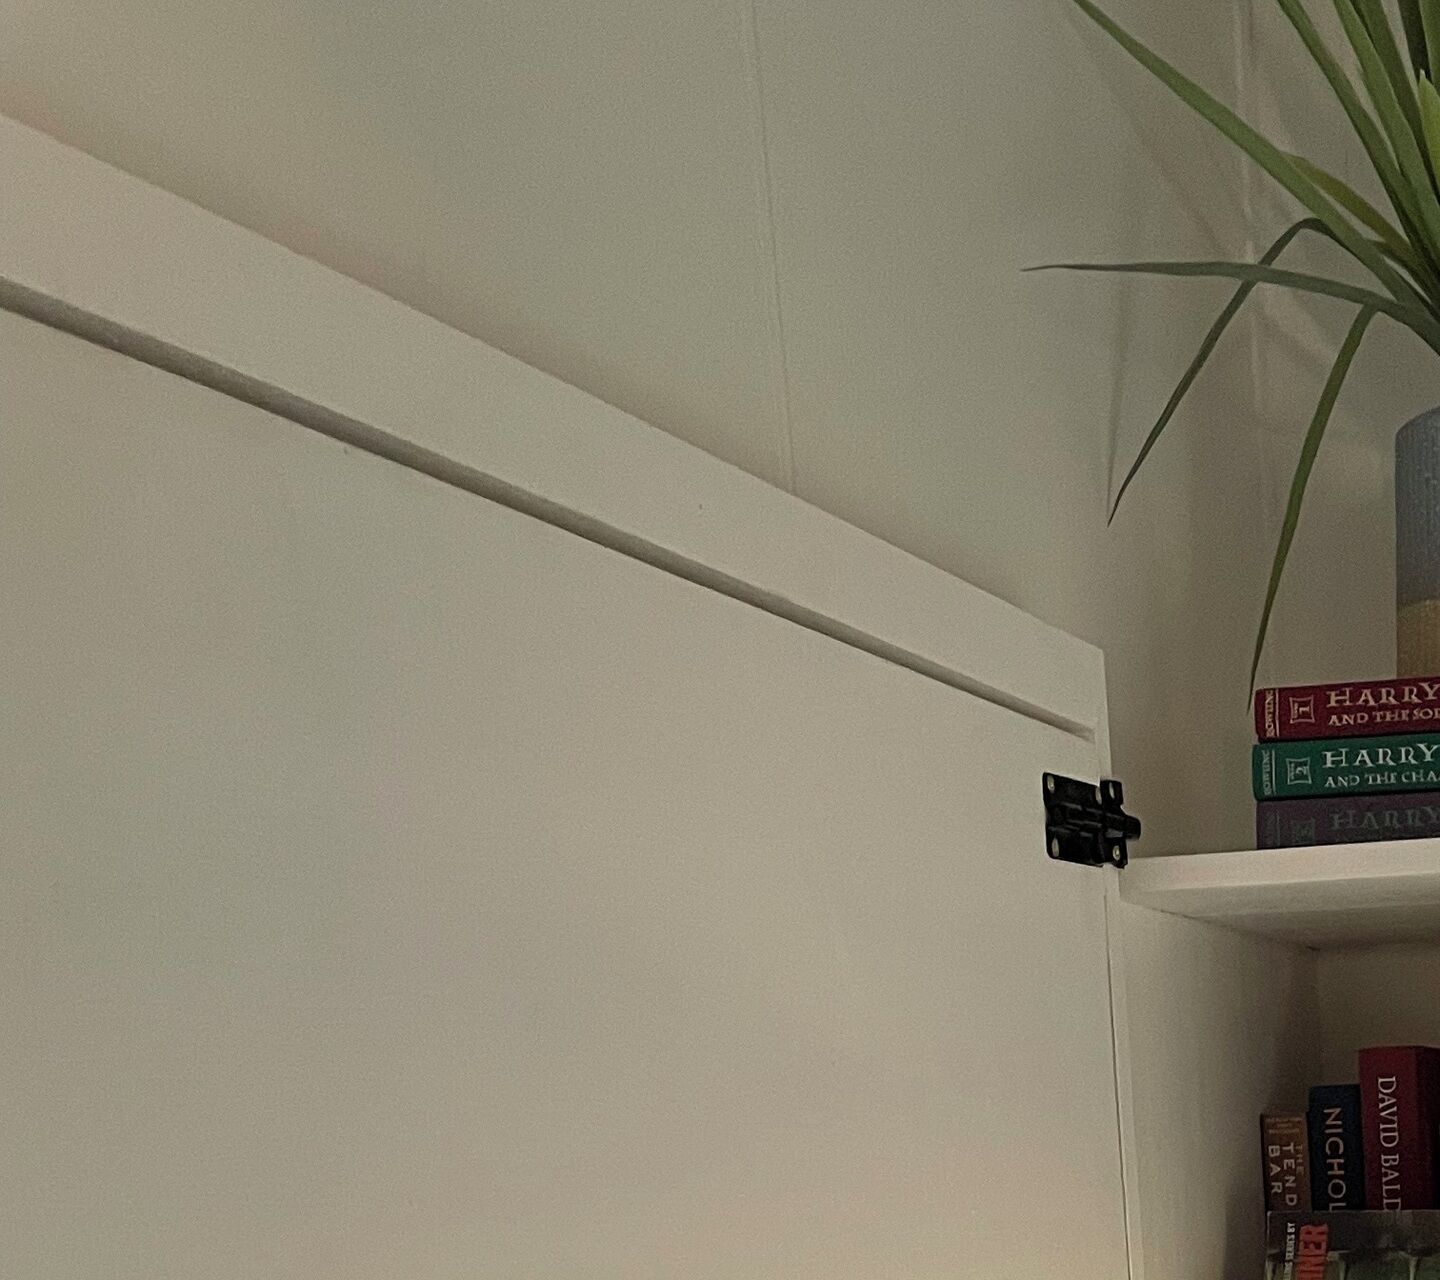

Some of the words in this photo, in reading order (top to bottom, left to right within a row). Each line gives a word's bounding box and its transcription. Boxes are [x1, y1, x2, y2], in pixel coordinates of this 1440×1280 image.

[1328, 713, 1368, 726] AND
[1373, 708, 1410, 722] THE
[1322, 743, 1440, 768] HARRY
[1324, 775, 1359, 788] AND
[1365, 771, 1397, 785] THE
[1378, 1076, 1400, 1147] DAVID
[1267, 1145, 1283, 1194] BAR
